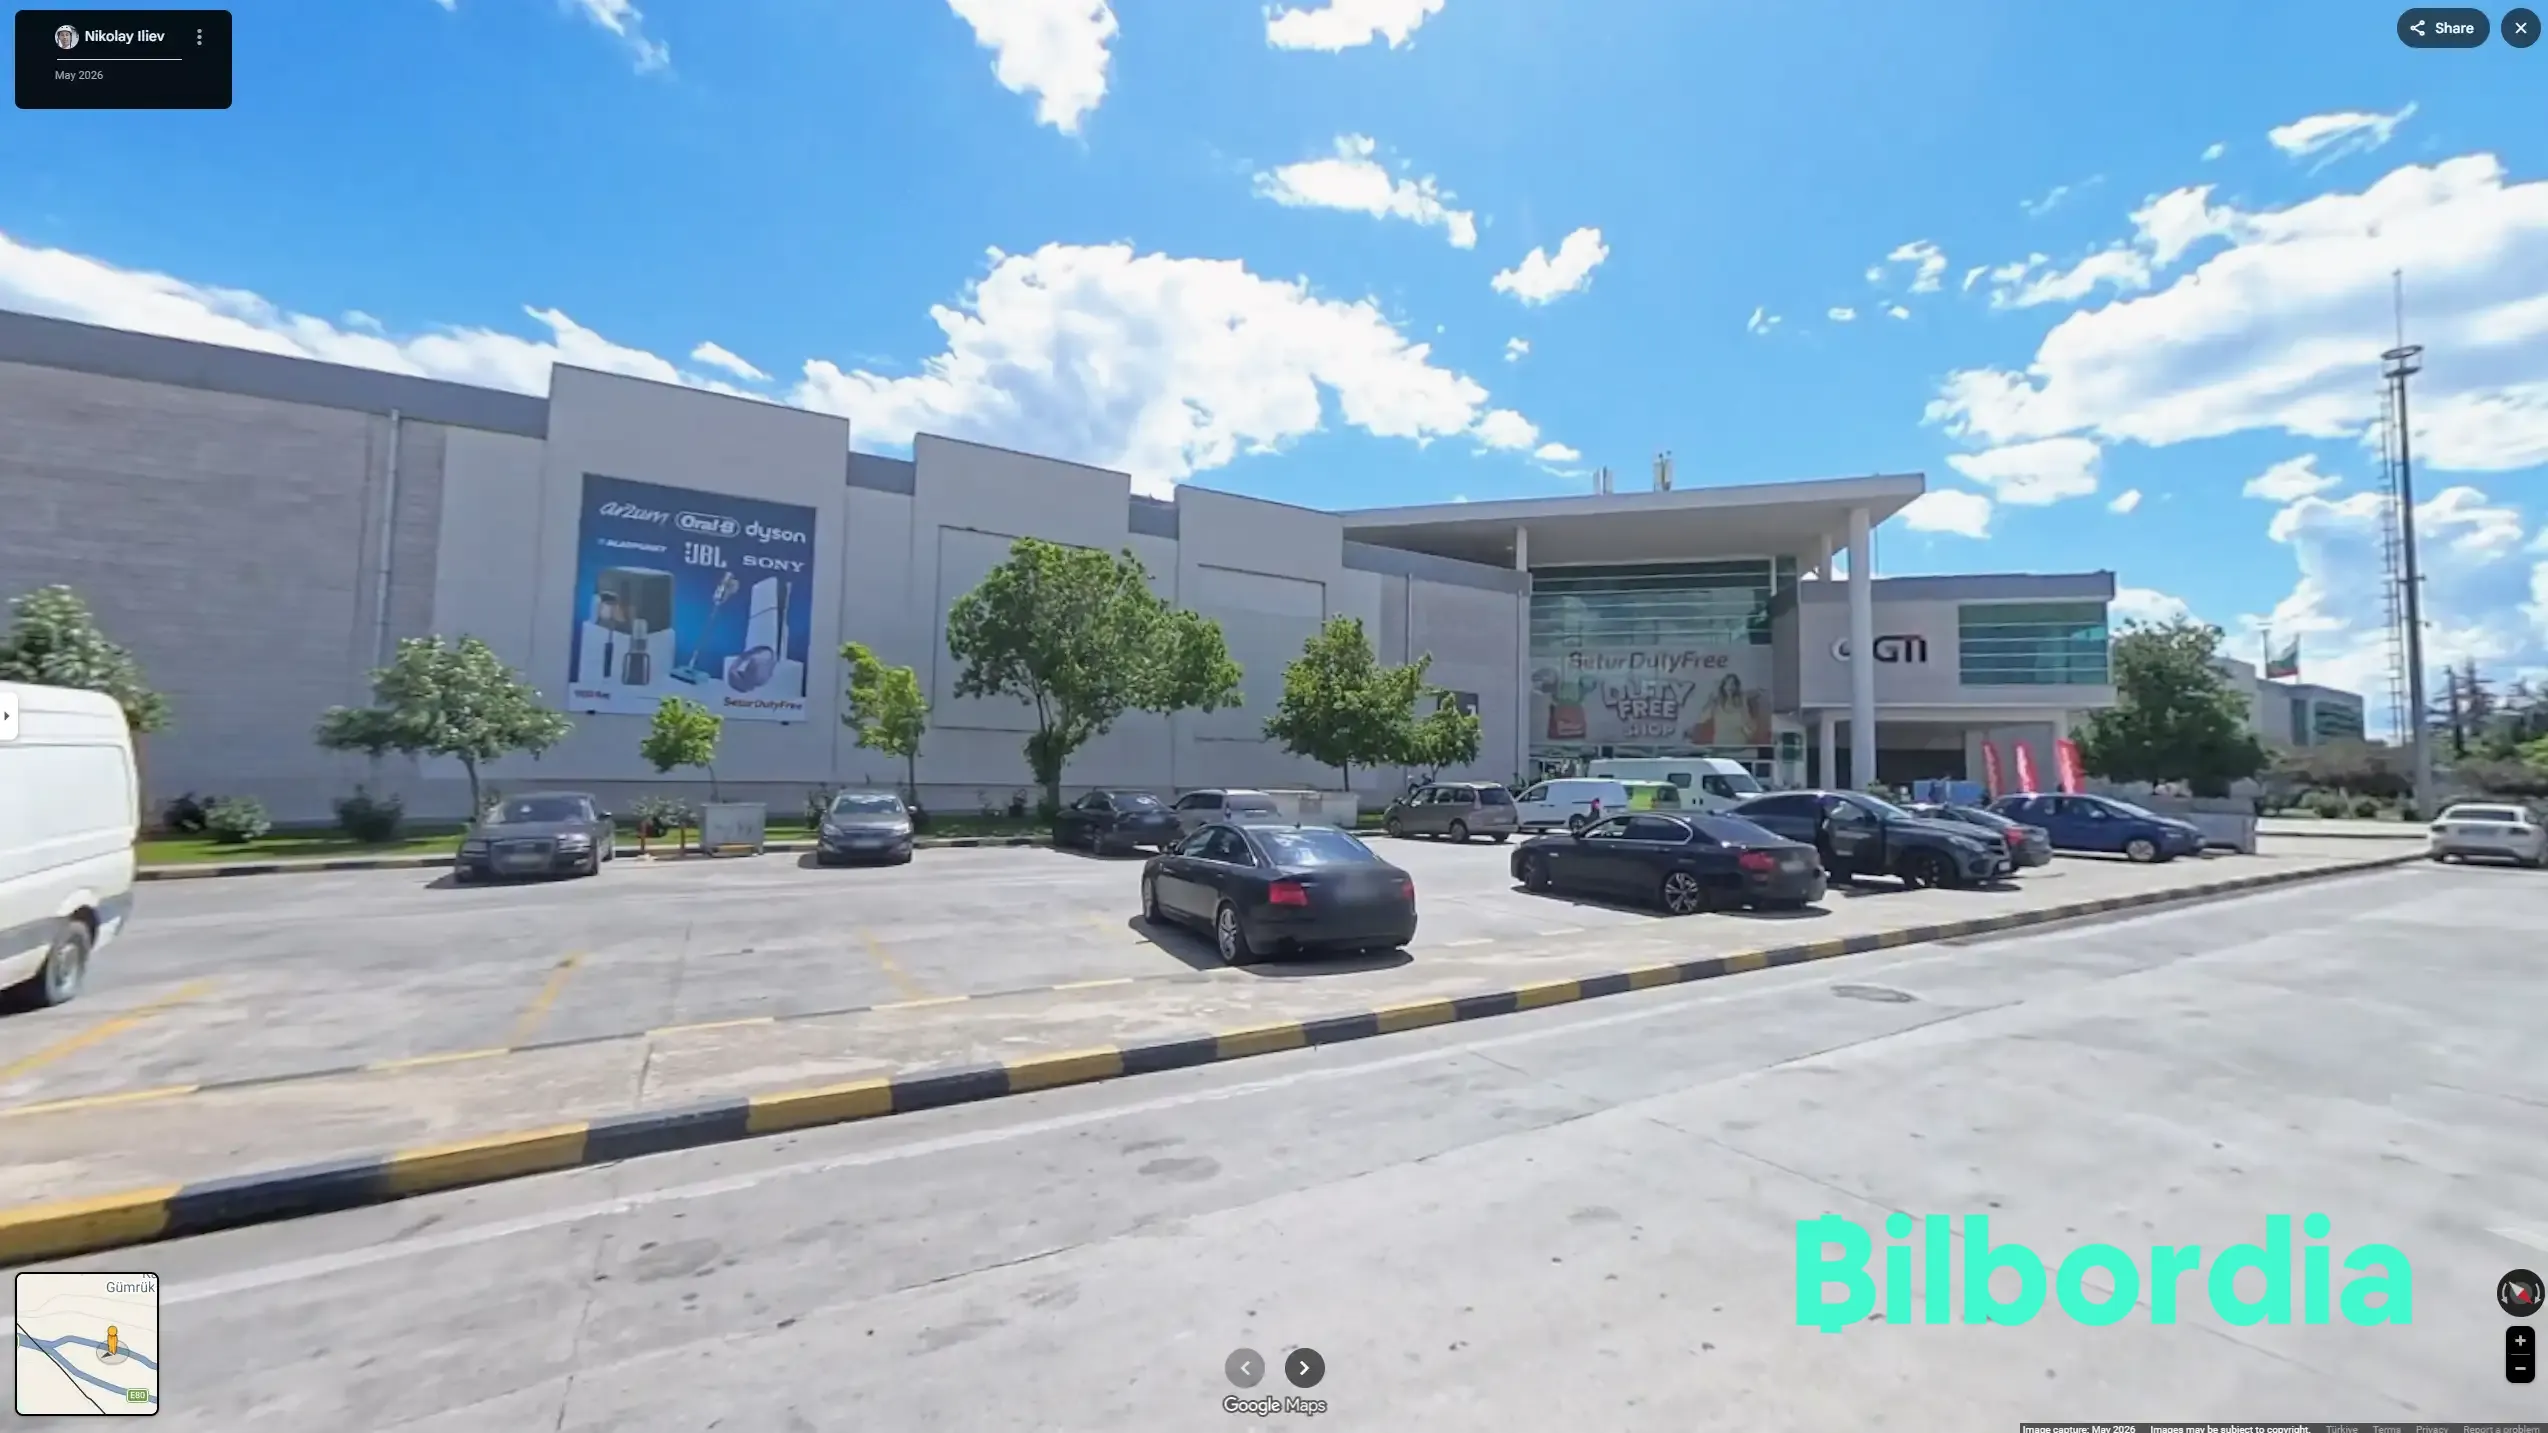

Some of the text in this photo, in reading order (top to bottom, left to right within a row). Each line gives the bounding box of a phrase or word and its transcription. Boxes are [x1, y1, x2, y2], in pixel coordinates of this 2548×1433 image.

[599, 501, 807, 543] arzum Oral-B dyson
[685, 541, 728, 568] JBL
[743, 555, 805, 573] SONY
[1618, 698, 1678, 719] FREE
